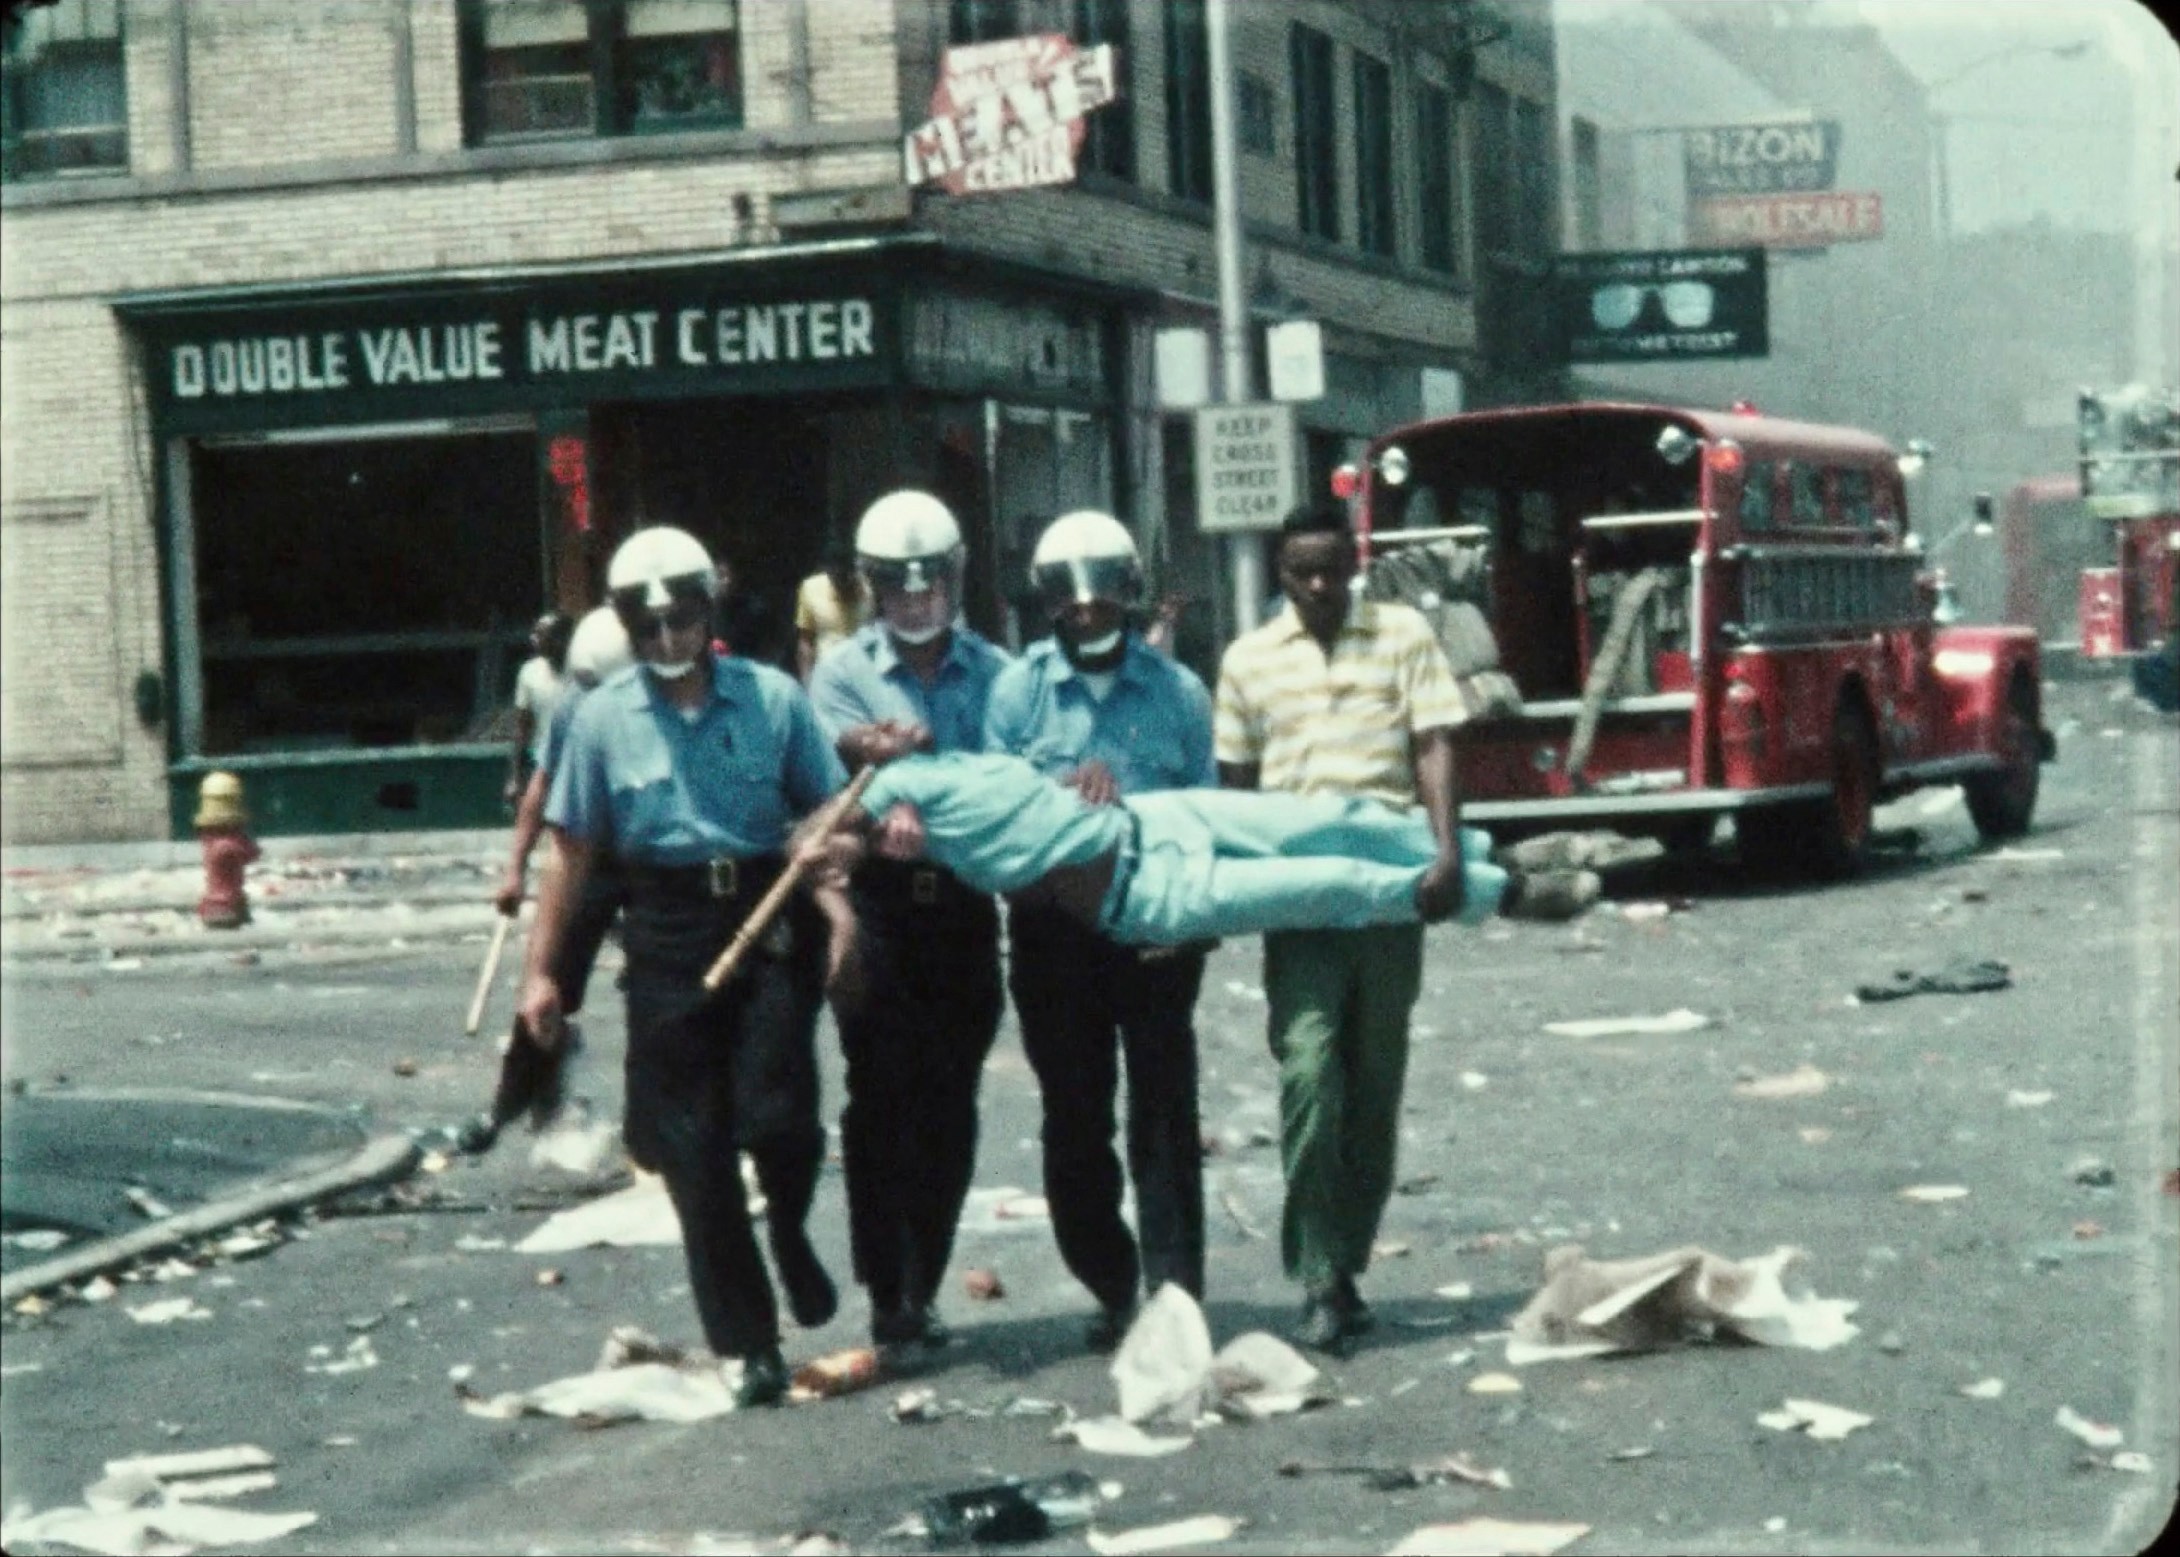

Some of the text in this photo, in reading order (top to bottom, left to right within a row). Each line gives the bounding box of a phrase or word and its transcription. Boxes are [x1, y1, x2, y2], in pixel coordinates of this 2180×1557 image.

[964, 126, 1077, 183] CENTER
[172, 334, 349, 398] DOUBLE
[359, 322, 502, 384] VALUE
[528, 312, 659, 374] MEAT
[677, 299, 875, 366] CENTER
[1214, 416, 1272, 437] KEEP
[1213, 469, 1279, 489] STREET
[1214, 495, 1277, 516] CLEAR
